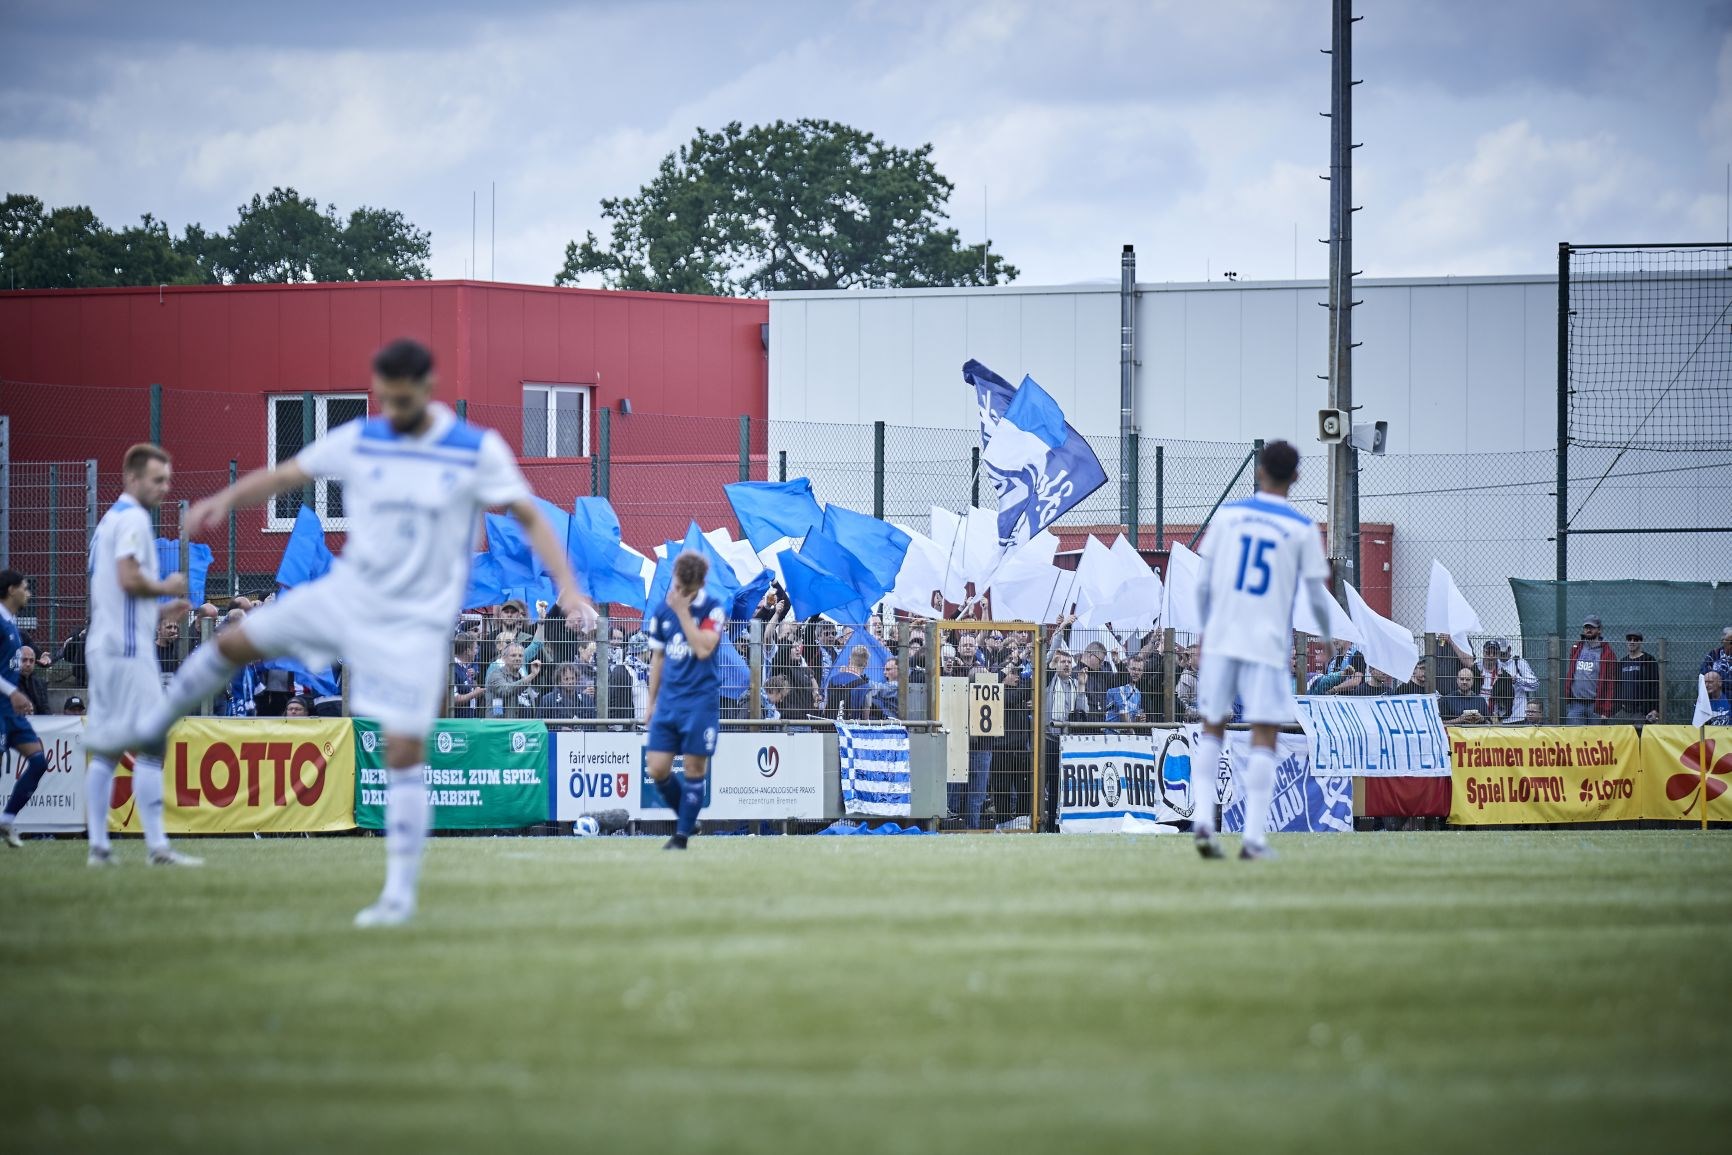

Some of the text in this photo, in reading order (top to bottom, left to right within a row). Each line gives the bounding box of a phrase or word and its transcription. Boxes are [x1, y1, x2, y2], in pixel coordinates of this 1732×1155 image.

[1234, 533, 1276, 596] 15
[973, 684, 1000, 701] TOR
[980, 704, 993, 733] 8
[569, 751, 630, 764] fair versichert
[1454, 741, 1618, 768] Träumen reicht nicht.
[361, 768, 387, 784] DER
[468, 769, 501, 785] ZUM
[502, 768, 541, 784] SPIEL.
[569, 768, 613, 798] ÖVB
[1062, 764, 1100, 808] BAG
[776, 796, 798, 805] Bremen
[799, 786, 816, 794] PRAXIS
[1466, 776, 1567, 809] Spiel LOTTO!
[1594, 778, 1633, 801] LOTTO
